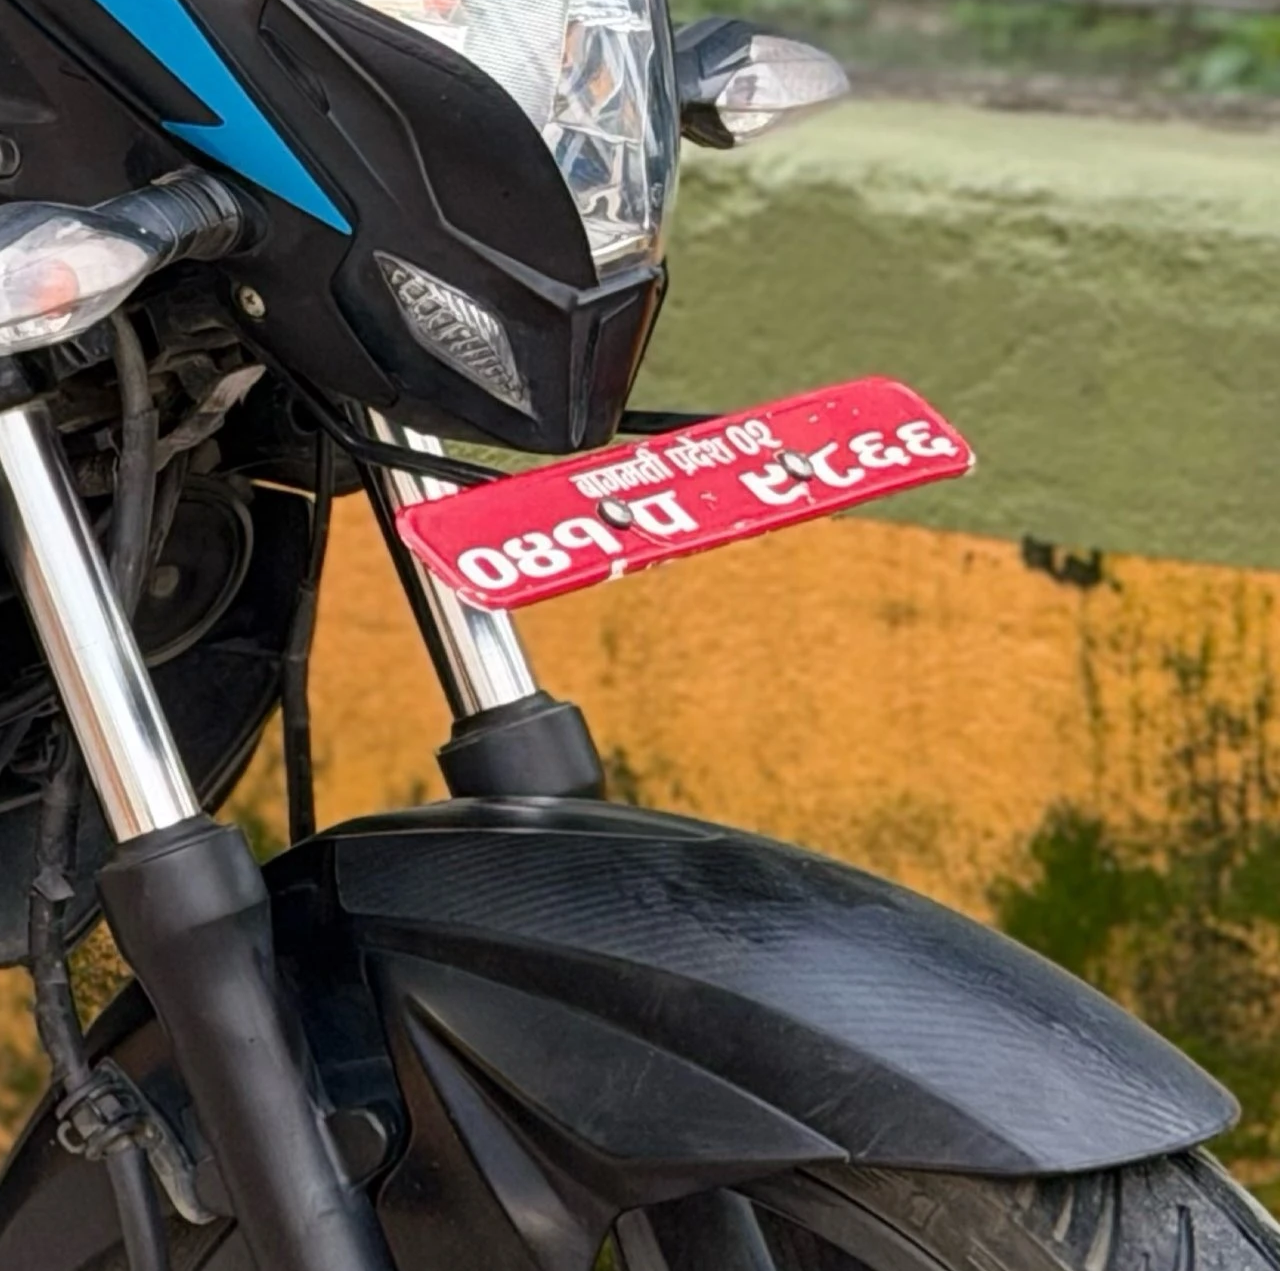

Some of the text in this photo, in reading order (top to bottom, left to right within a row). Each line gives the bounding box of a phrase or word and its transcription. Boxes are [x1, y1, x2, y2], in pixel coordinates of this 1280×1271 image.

[568, 441, 676, 499] बागमती
[663, 432, 737, 477] प्रदेश
[456, 516, 624, 590] ०४१
[628, 489, 700, 537] प
